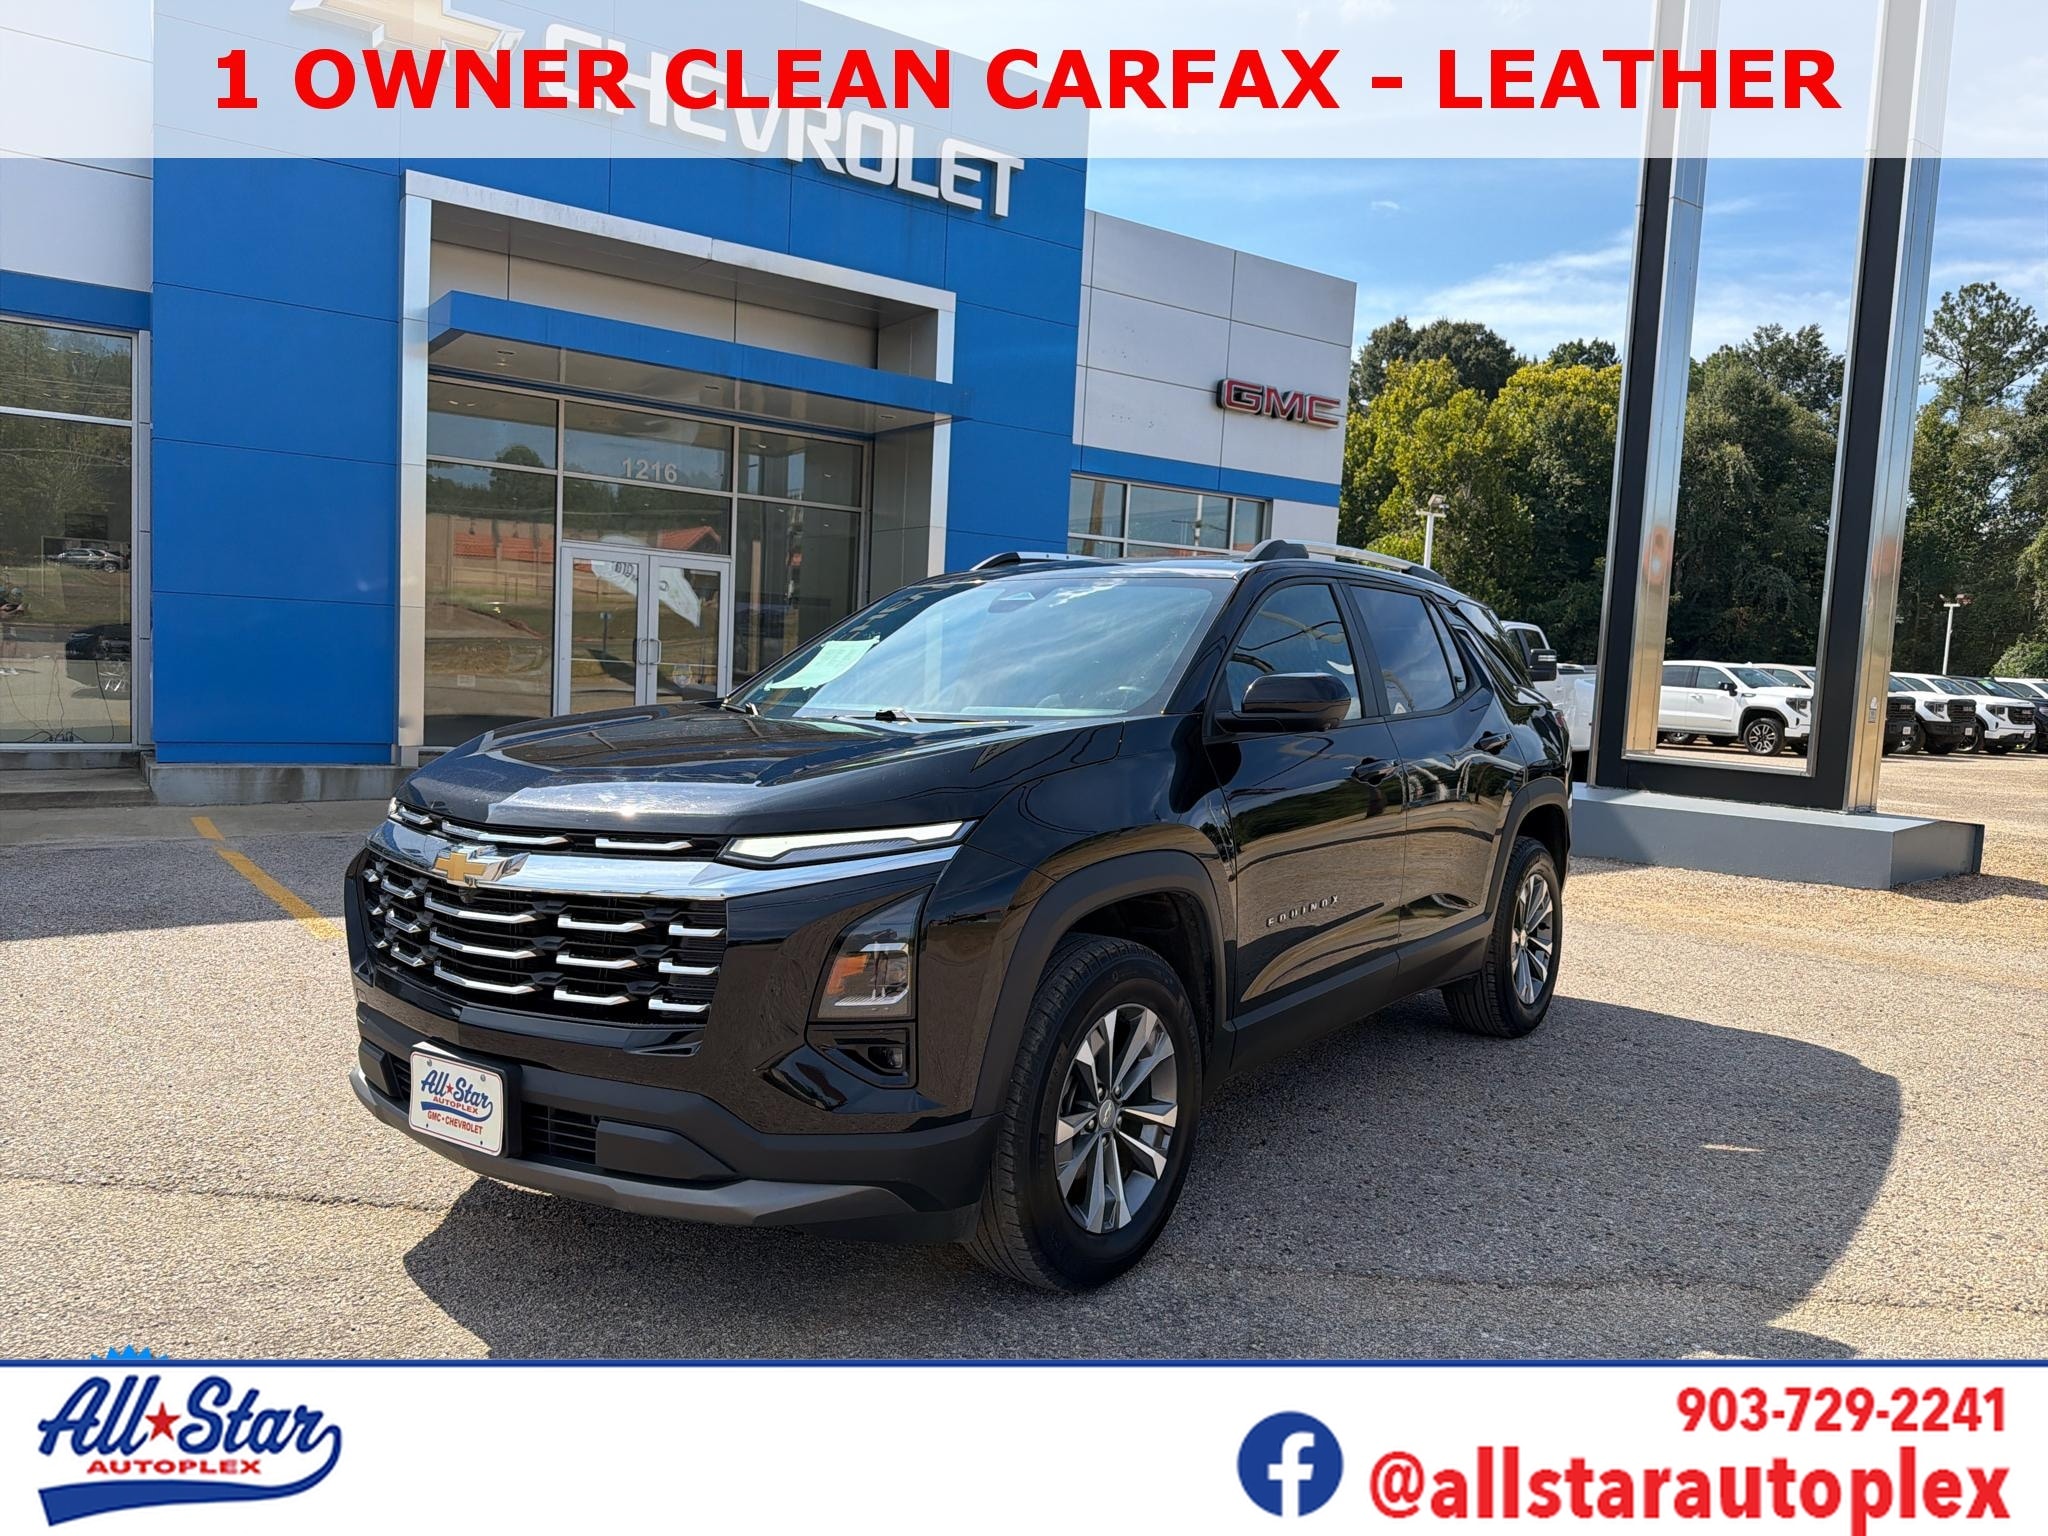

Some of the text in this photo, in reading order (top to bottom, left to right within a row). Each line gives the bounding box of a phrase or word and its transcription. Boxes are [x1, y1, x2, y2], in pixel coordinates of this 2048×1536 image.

[545, 23, 1024, 217] CHEVROLET
[1217, 378, 1341, 428] GMC
[623, 457, 677, 483] 1216
[421, 1069, 490, 1109] All Star
[433, 1096, 479, 1115] AUTOPLEX
[427, 1110, 484, 1135] GMC CHEVROLET
